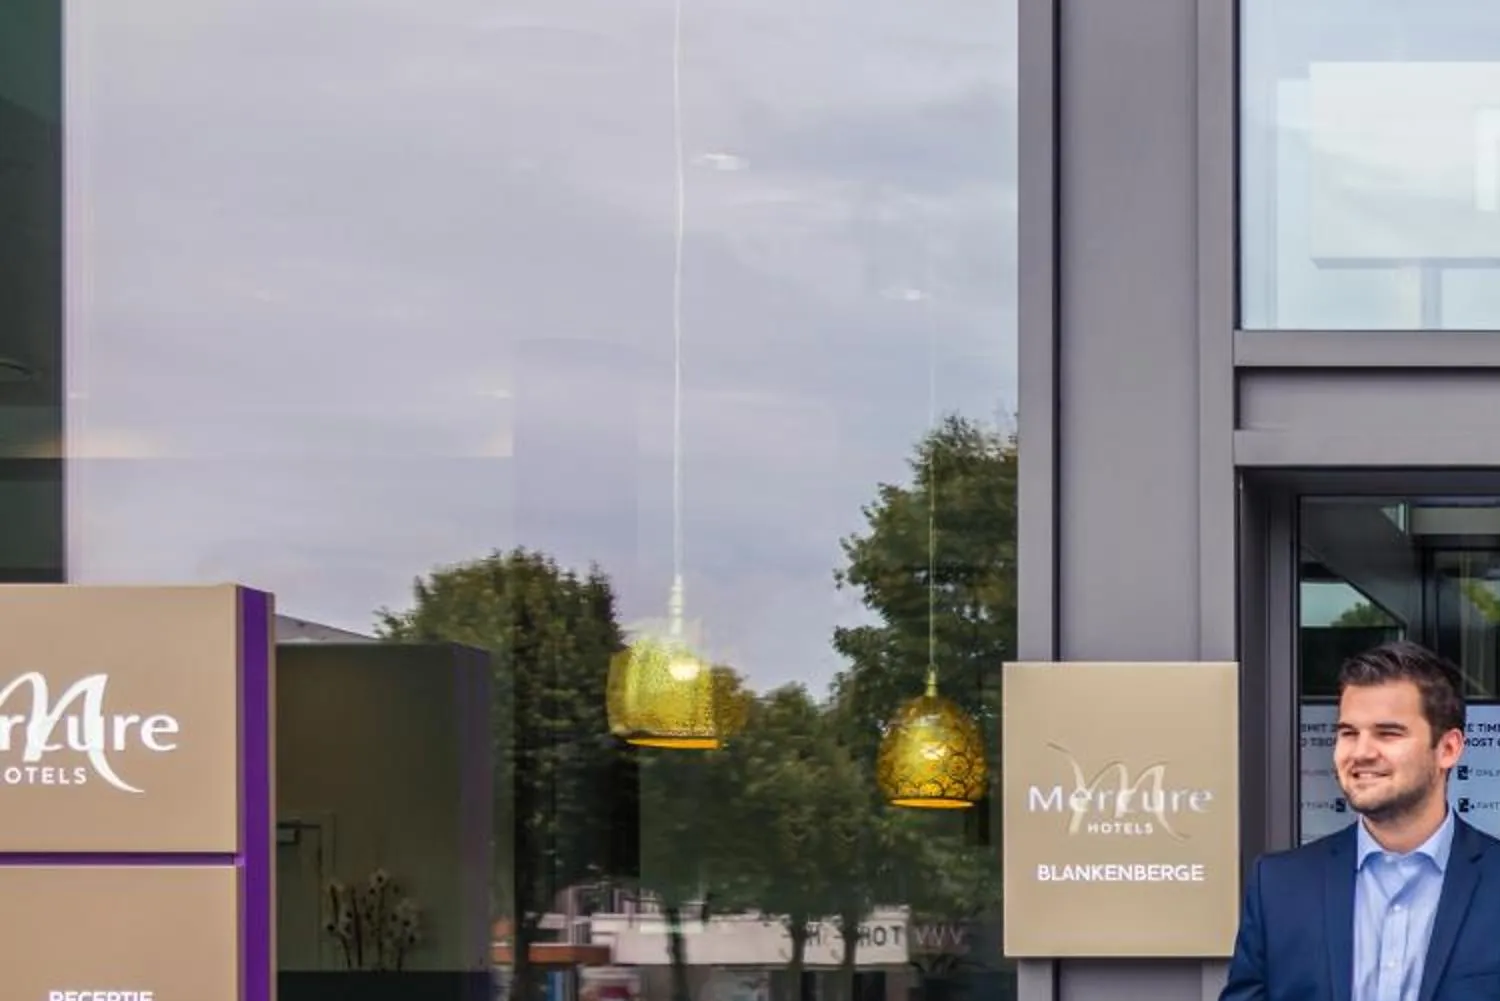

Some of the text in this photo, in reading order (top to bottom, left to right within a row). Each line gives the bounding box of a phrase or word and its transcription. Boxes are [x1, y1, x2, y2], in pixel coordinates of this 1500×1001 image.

[4, 767, 87, 785] OTELS
[1028, 785, 1213, 813] Mercure
[1087, 823, 1153, 834] HOTELS
[1037, 864, 1205, 882] BLANKENBERGE
